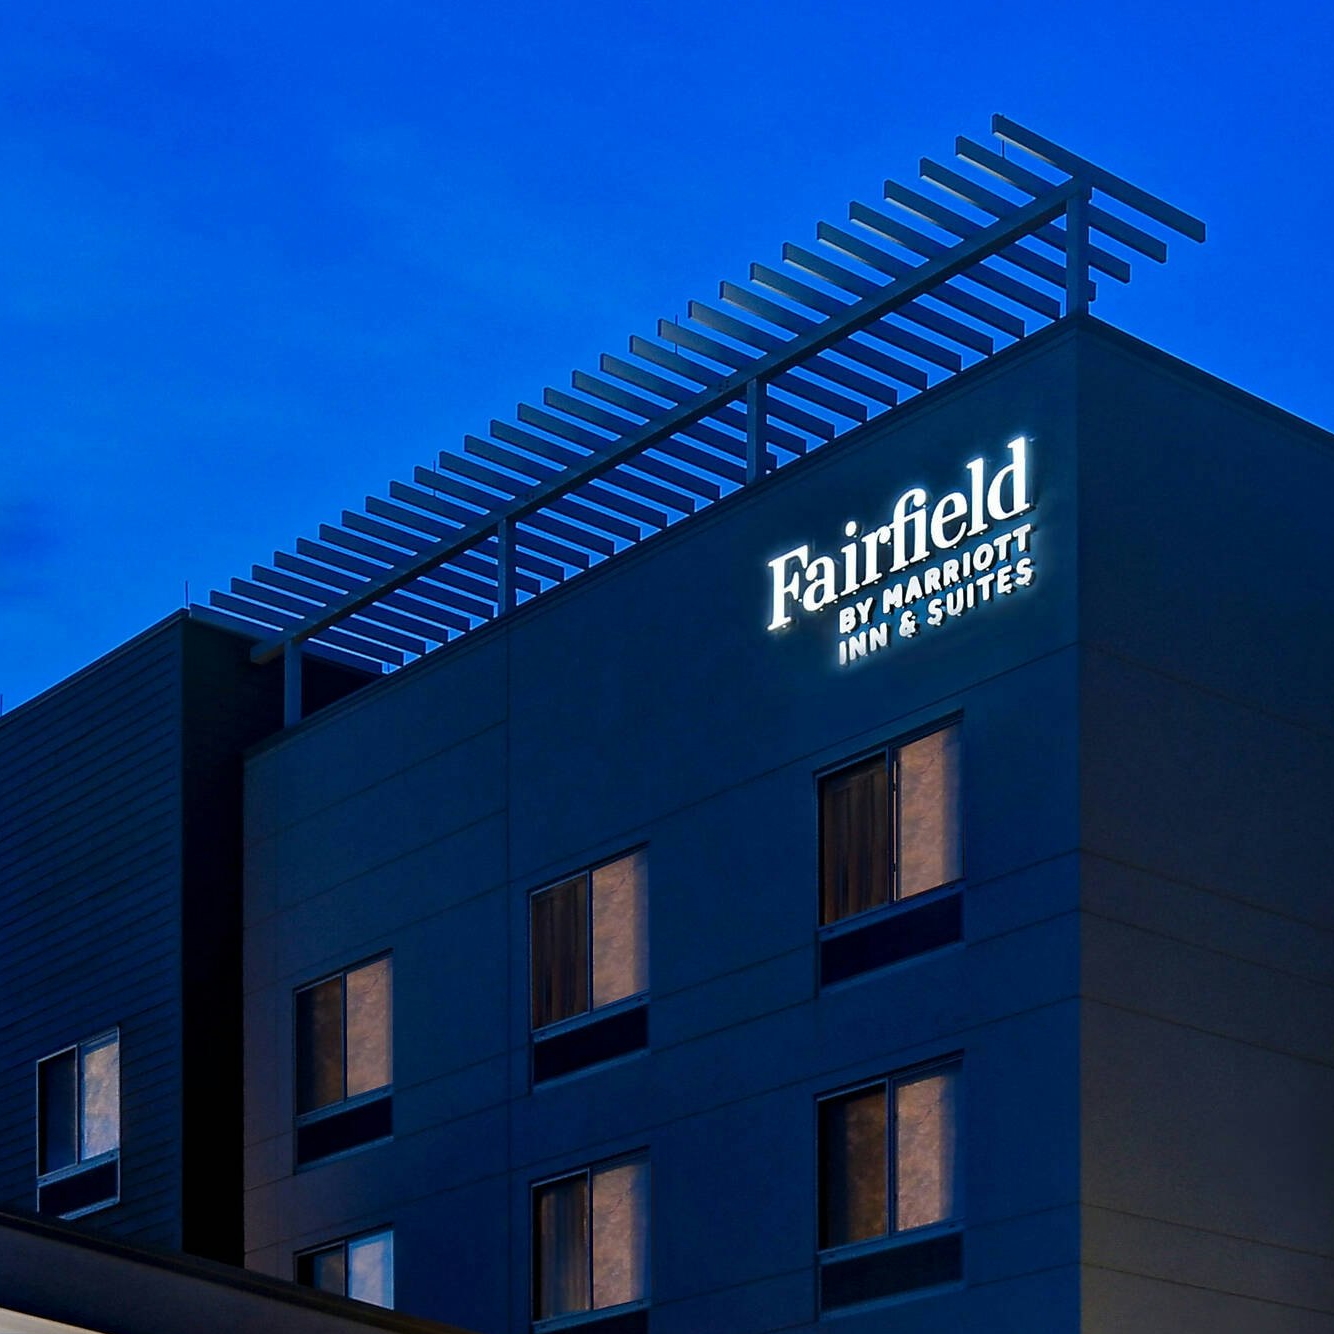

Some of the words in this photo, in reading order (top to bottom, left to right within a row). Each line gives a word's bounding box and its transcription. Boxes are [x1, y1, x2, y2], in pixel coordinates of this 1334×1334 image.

[767, 436, 1030, 631] Fairfield
[839, 597, 874, 634] BY
[883, 523, 1032, 615] MARRIOTT
[839, 621, 888, 665] INN
[899, 610, 917, 638] &
[927, 557, 1033, 626] SUITES
